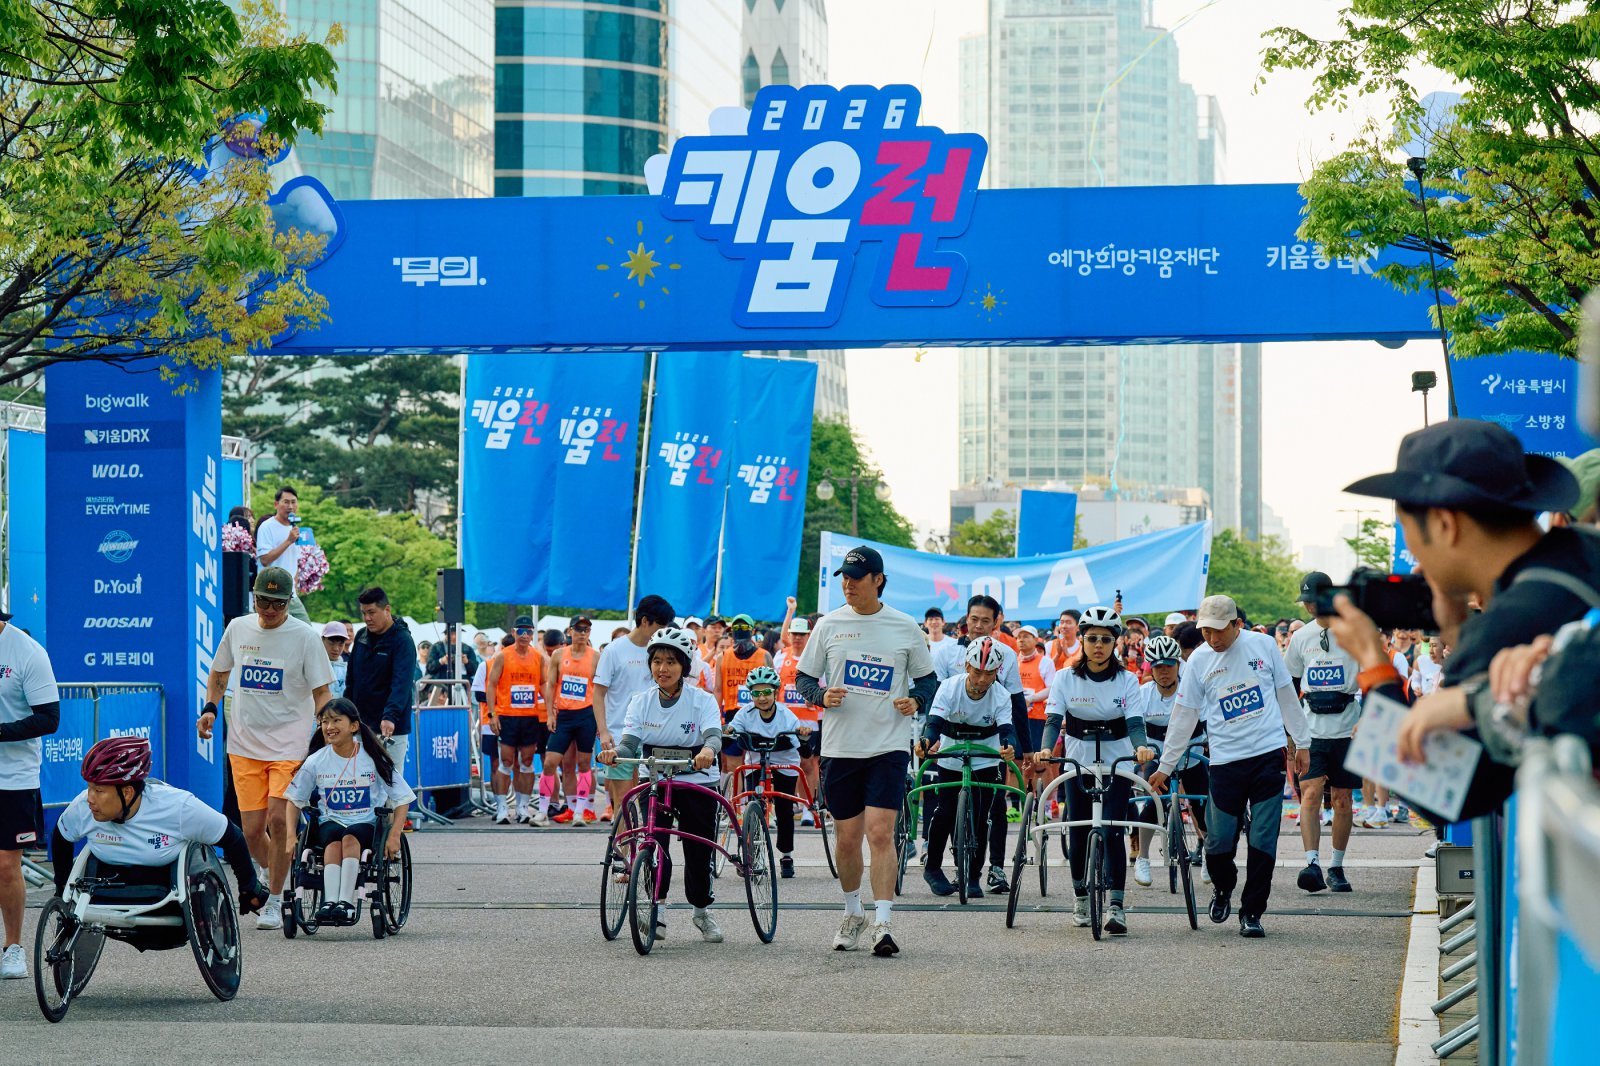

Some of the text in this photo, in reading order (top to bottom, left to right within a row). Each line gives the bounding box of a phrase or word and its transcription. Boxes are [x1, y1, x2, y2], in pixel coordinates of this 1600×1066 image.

[762, 99, 907, 131] 2026
[674, 140, 973, 313] 키움런
[1048, 243, 1220, 279] 예강희망키움재단
[493, 386, 535, 399] 2026
[1502, 379, 1566, 394] 서울특별시
[85, 393, 150, 413] bigwalk
[471, 399, 550, 450] 키움런
[1525, 415, 1566, 430] 소방청
[98, 428, 150, 444] 키움DRX
[675, 431, 709, 444] 2026
[658, 442, 723, 487] 키움런
[755, 455, 787, 466] 2026
[92, 464, 144, 478] WOLO.
[736, 464, 800, 504] 키움런
[94, 579, 136, 594] Dr.You
[83, 617, 154, 629] DOOSAN
[101, 652, 154, 667] 게토레이
[244, 668, 280, 684] 0026
[848, 663, 890, 683] 0027
[1310, 668, 1342, 681] 0024
[563, 682, 585, 693] 0106
[513, 692, 534, 701] 0124
[1223, 690, 1260, 713] 0023
[331, 789, 365, 804] 0137
